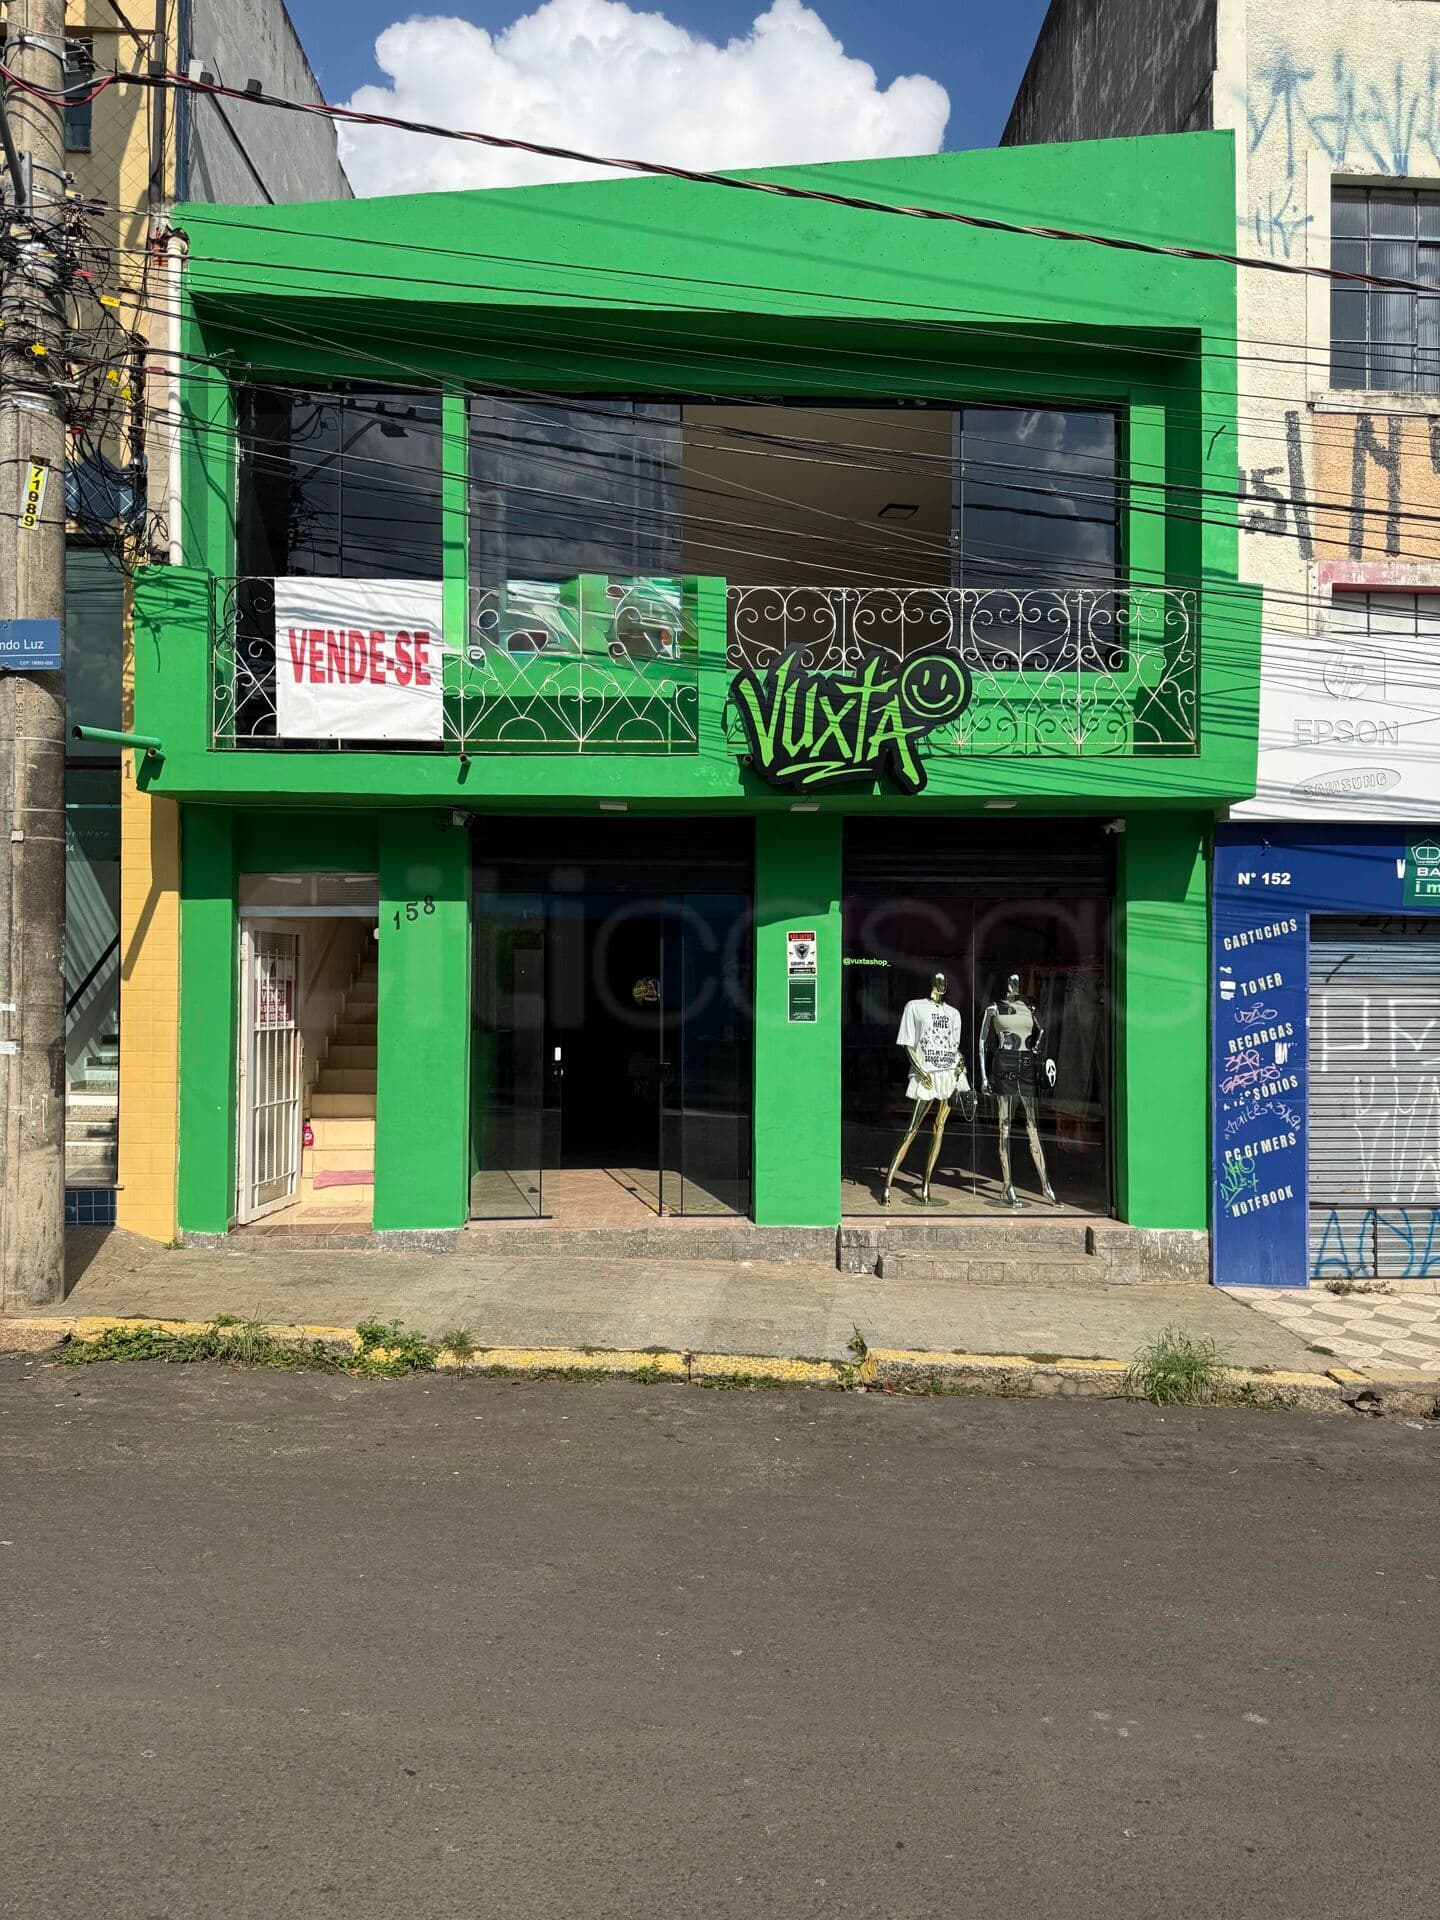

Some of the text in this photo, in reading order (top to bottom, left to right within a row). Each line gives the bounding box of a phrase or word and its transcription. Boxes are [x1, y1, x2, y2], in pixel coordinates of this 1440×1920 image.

[24, 639, 44, 649] Luz
[288, 628, 431, 686] VENDE-SE
[1293, 718, 1399, 746] EPSON
[1303, 772, 1387, 798] SAMSUNG
[1261, 872, 1291, 885] 152
[392, 894, 436, 931] 158
[1223, 918, 1298, 951] CARTUCHOS
[1240, 972, 1283, 996] TONER
[1228, 1022, 1294, 1053] RECARGAS
[1224, 1075, 1299, 1111] SÓRIOS
